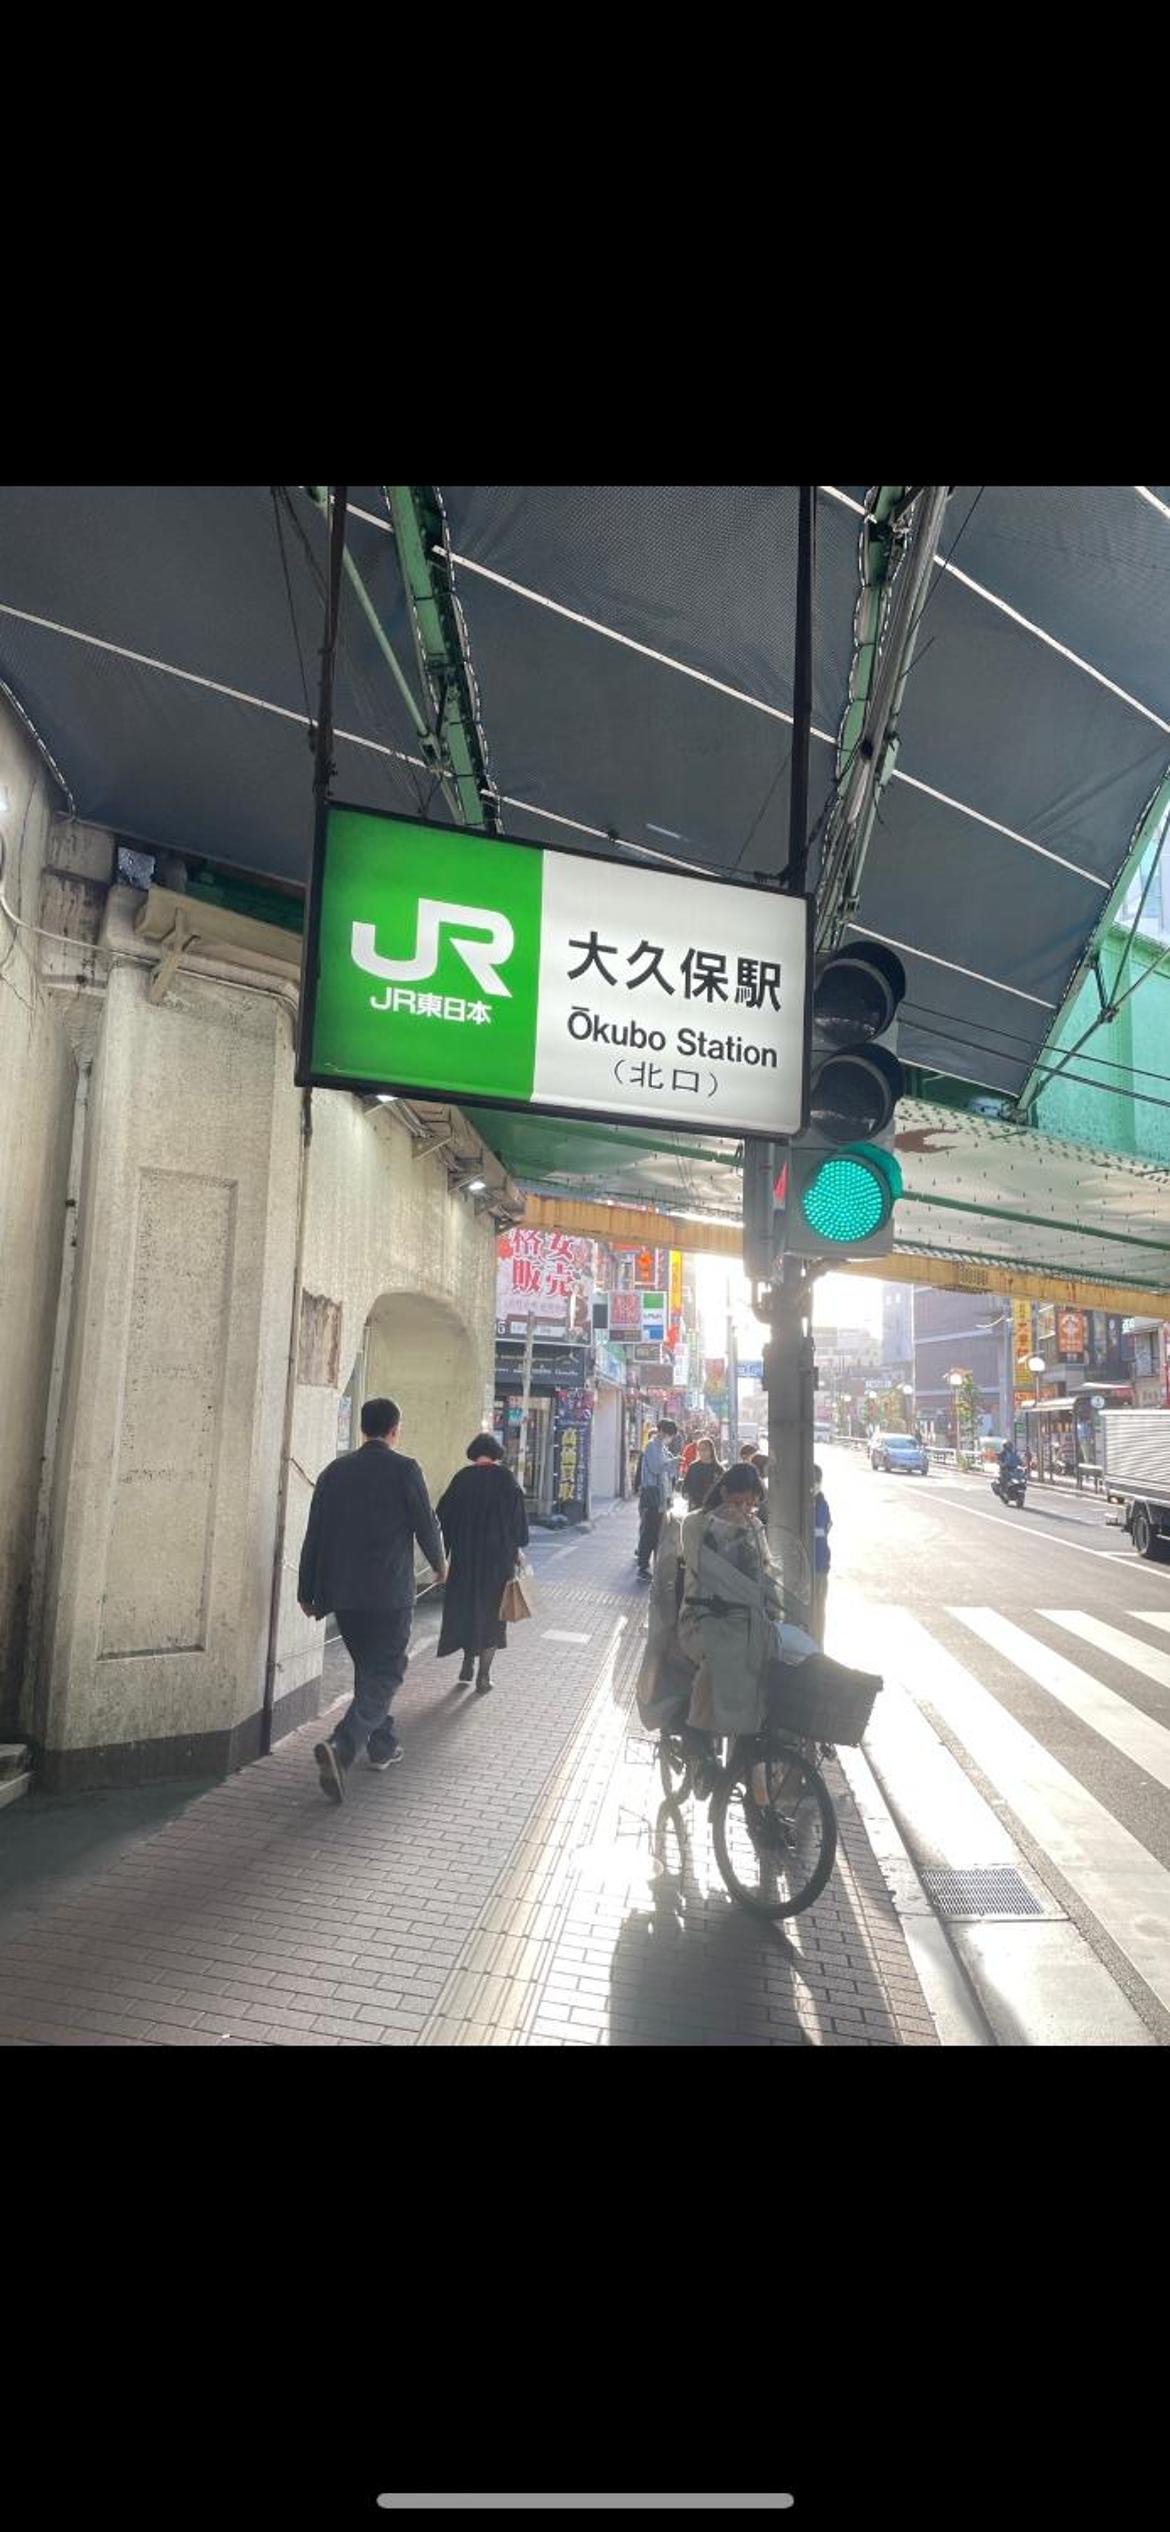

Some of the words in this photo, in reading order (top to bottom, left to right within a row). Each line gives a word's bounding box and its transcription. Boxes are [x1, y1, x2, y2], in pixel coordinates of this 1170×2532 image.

[352, 899, 514, 997] JR
[567, 931, 783, 1012] 大久保駅
[370, 987, 492, 1024] JR東日本
[567, 1006, 666, 1052] Ōkubo
[677, 1028, 779, 1069] Station
